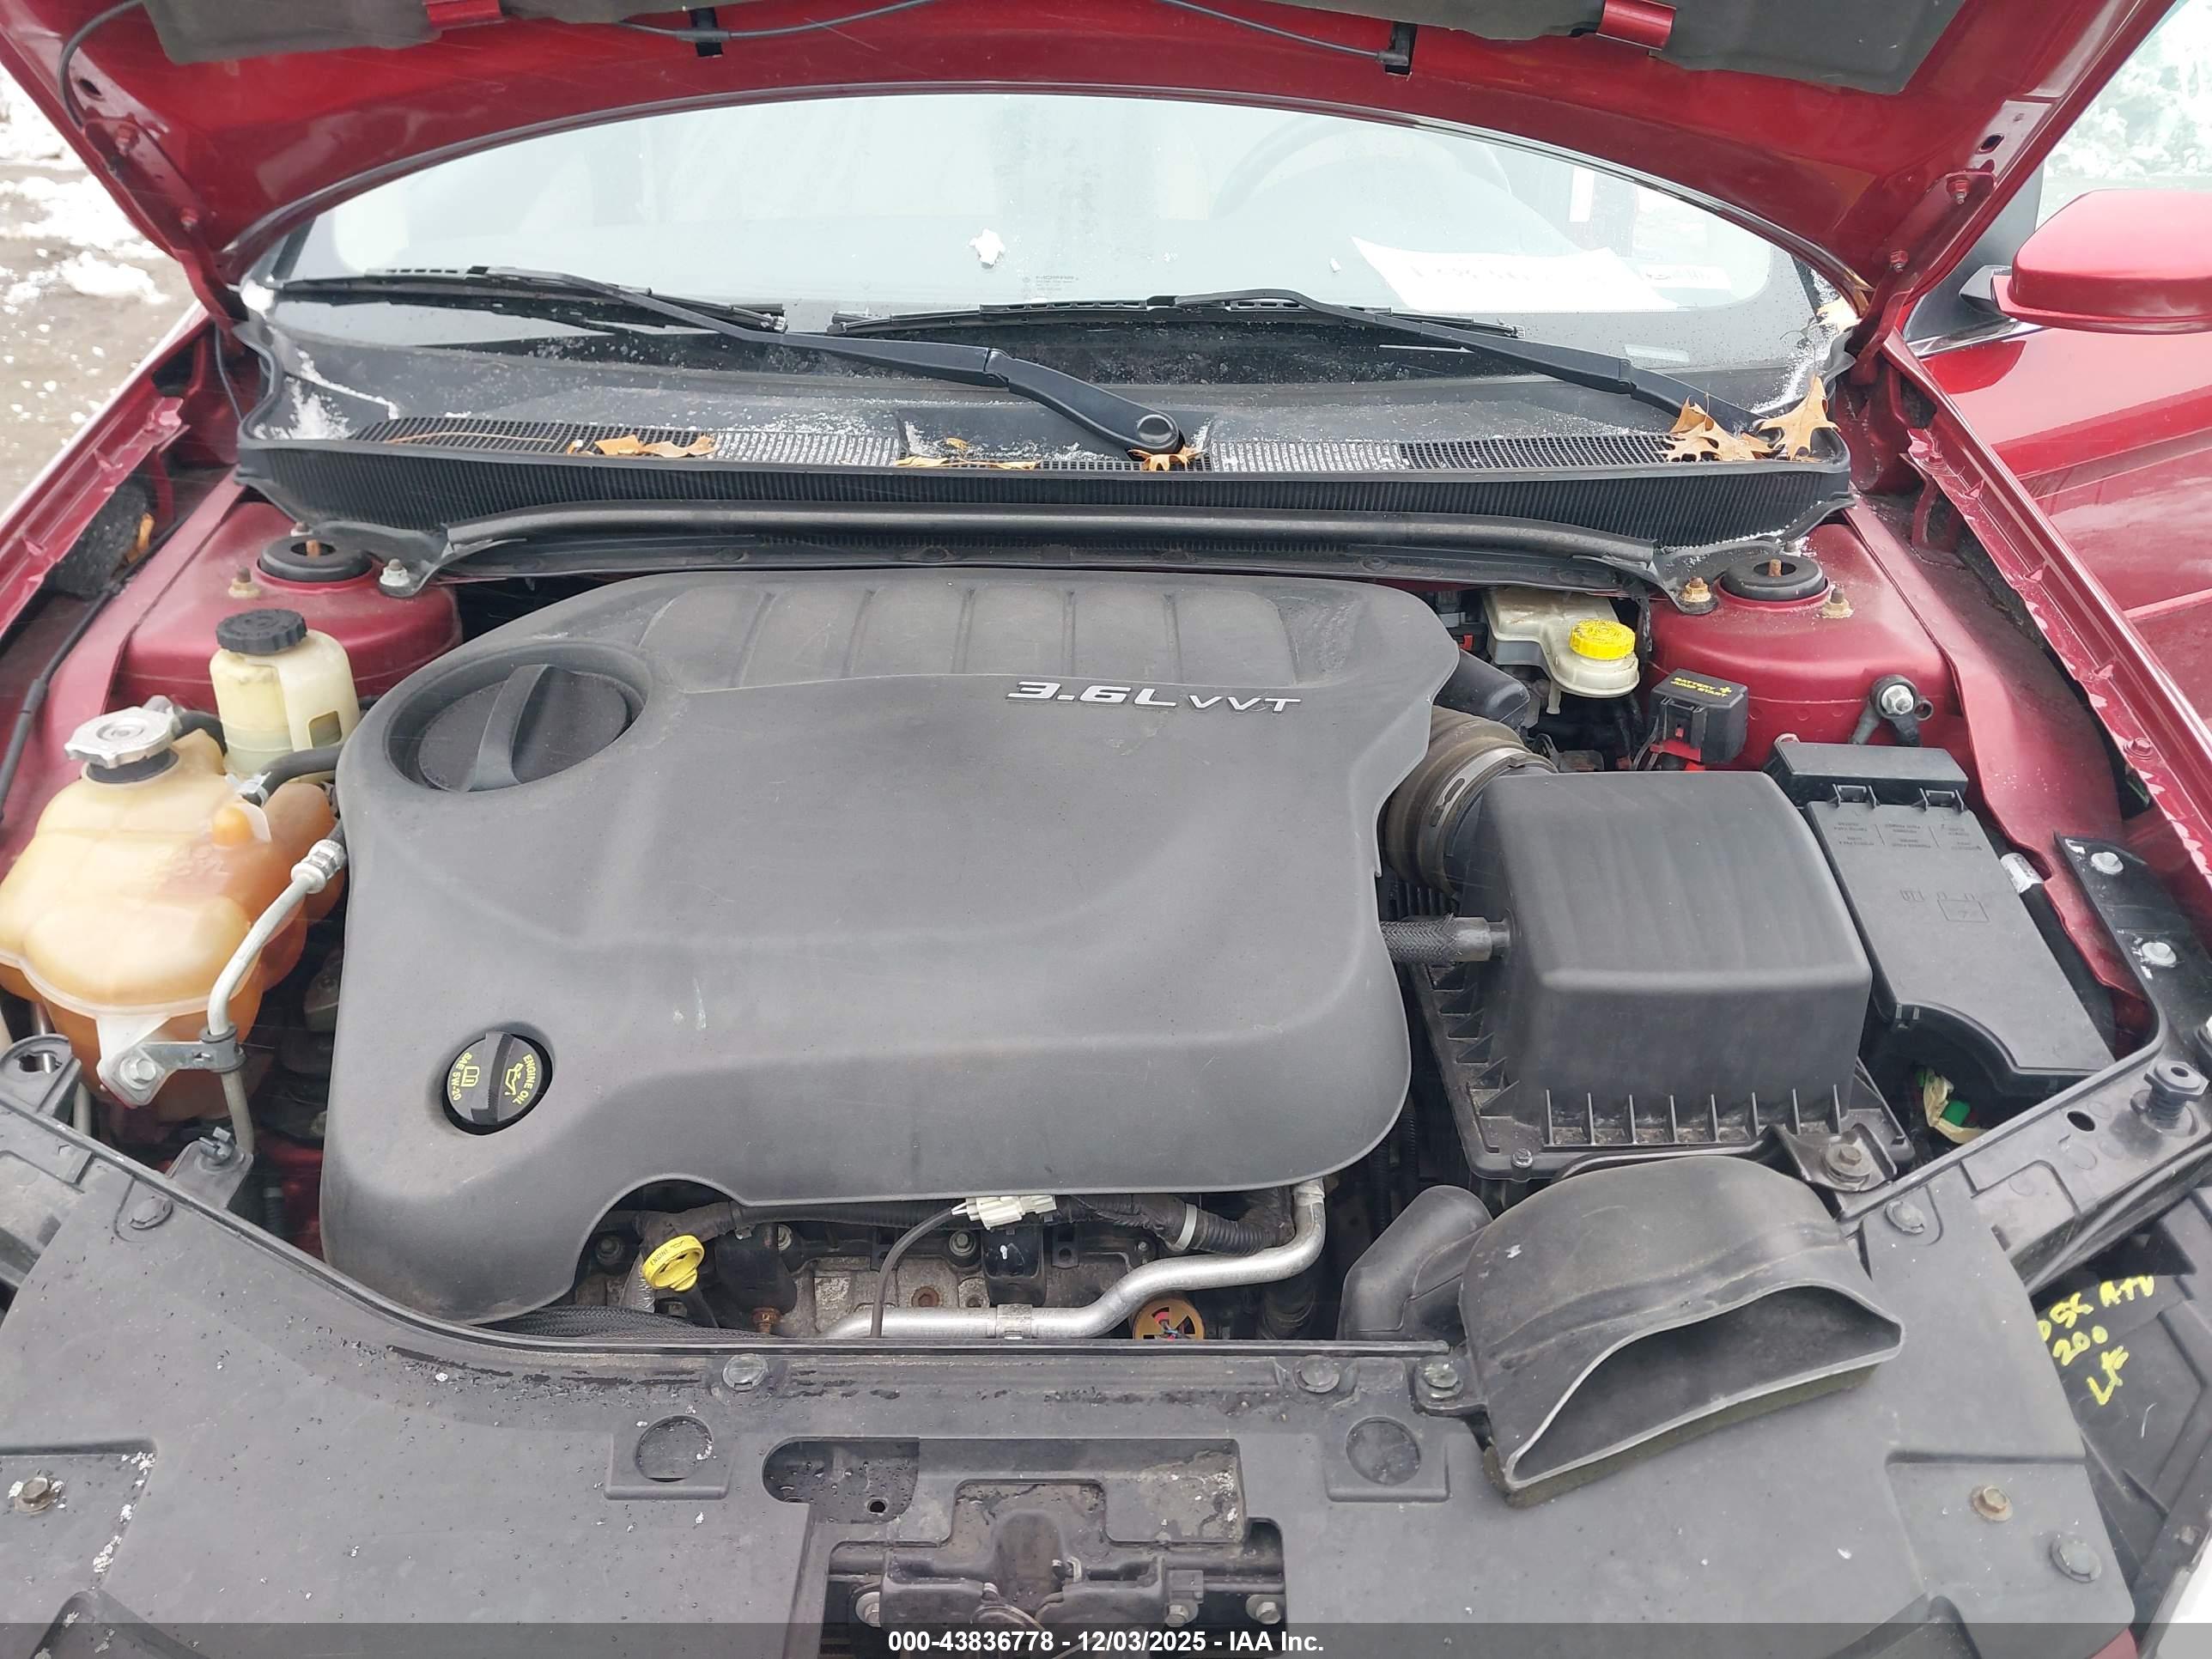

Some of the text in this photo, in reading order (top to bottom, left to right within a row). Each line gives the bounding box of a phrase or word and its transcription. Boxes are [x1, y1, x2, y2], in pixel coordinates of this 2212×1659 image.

[1006, 681, 1302, 714] 3.6L VVT
[1670, 680, 1729, 697] JUMP START
[1674, 677, 1717, 690] BATTERY
[451, 1072, 462, 1101] 5W-20
[512, 1054, 537, 1105] ENGINE OIL
